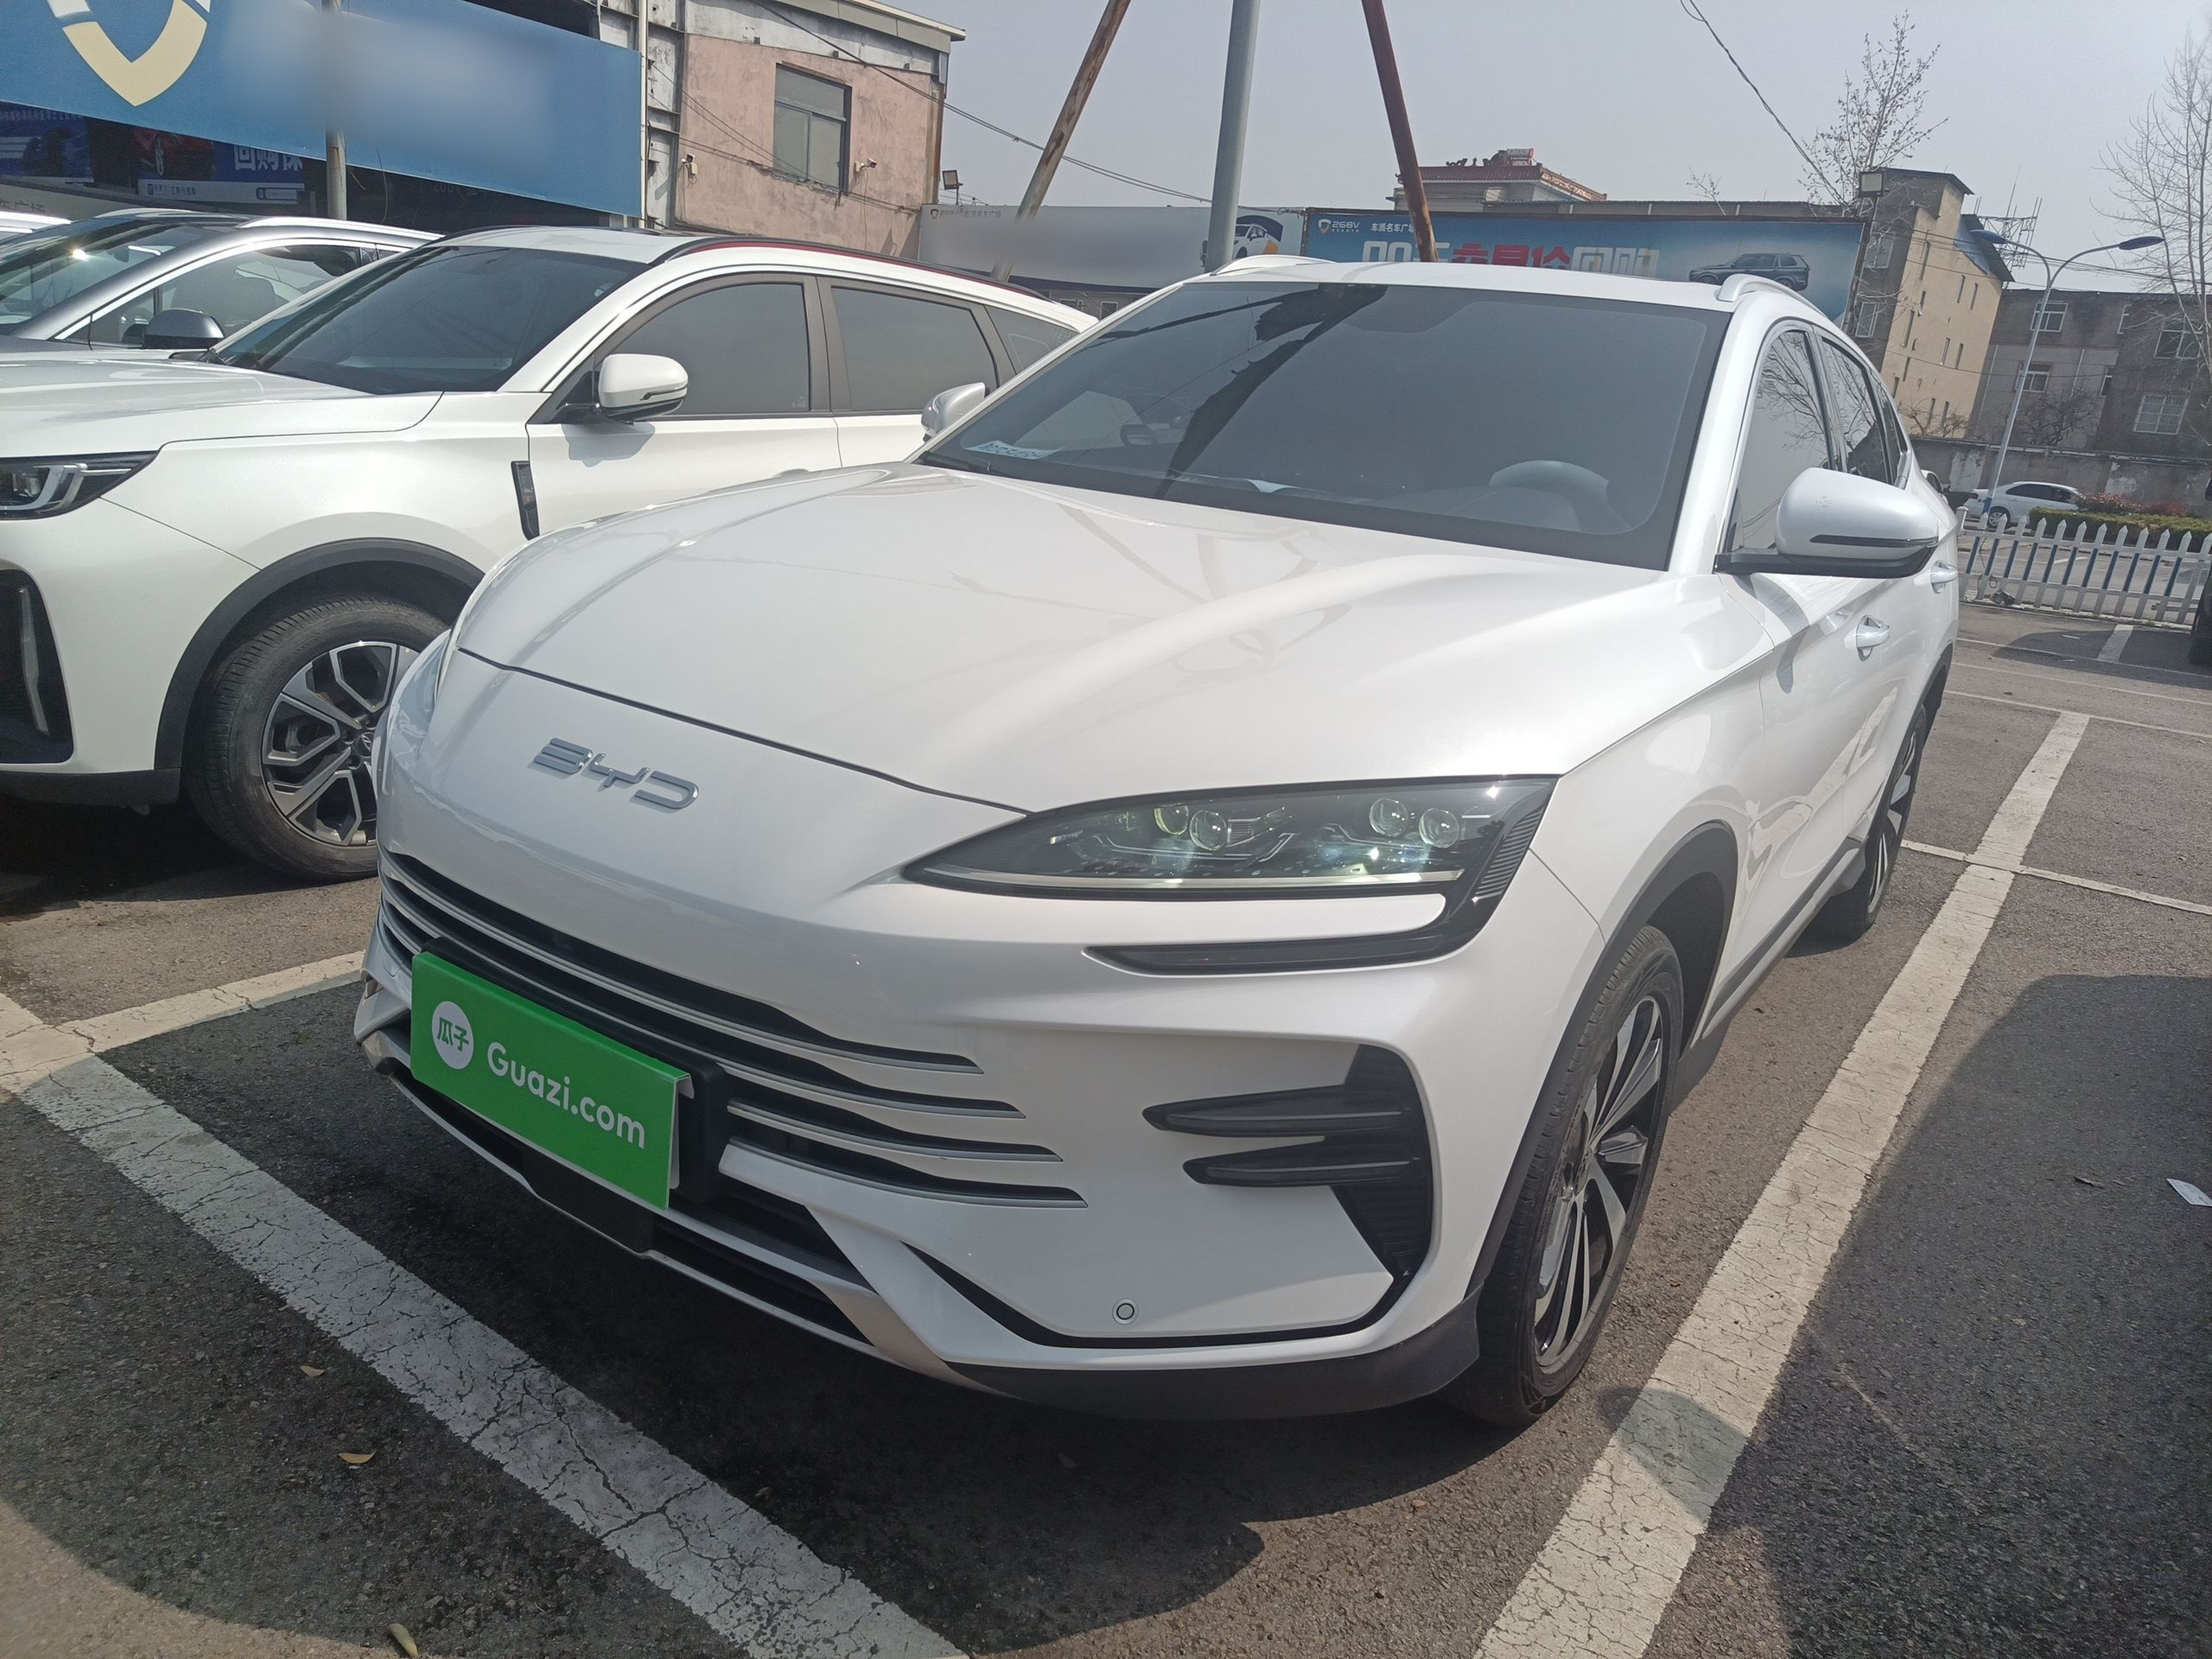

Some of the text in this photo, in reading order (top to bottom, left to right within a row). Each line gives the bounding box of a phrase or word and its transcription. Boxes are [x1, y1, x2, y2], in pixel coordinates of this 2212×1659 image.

[533, 737, 699, 809] BYD
[437, 1016, 645, 1149] 瓜子 Guazi.com
